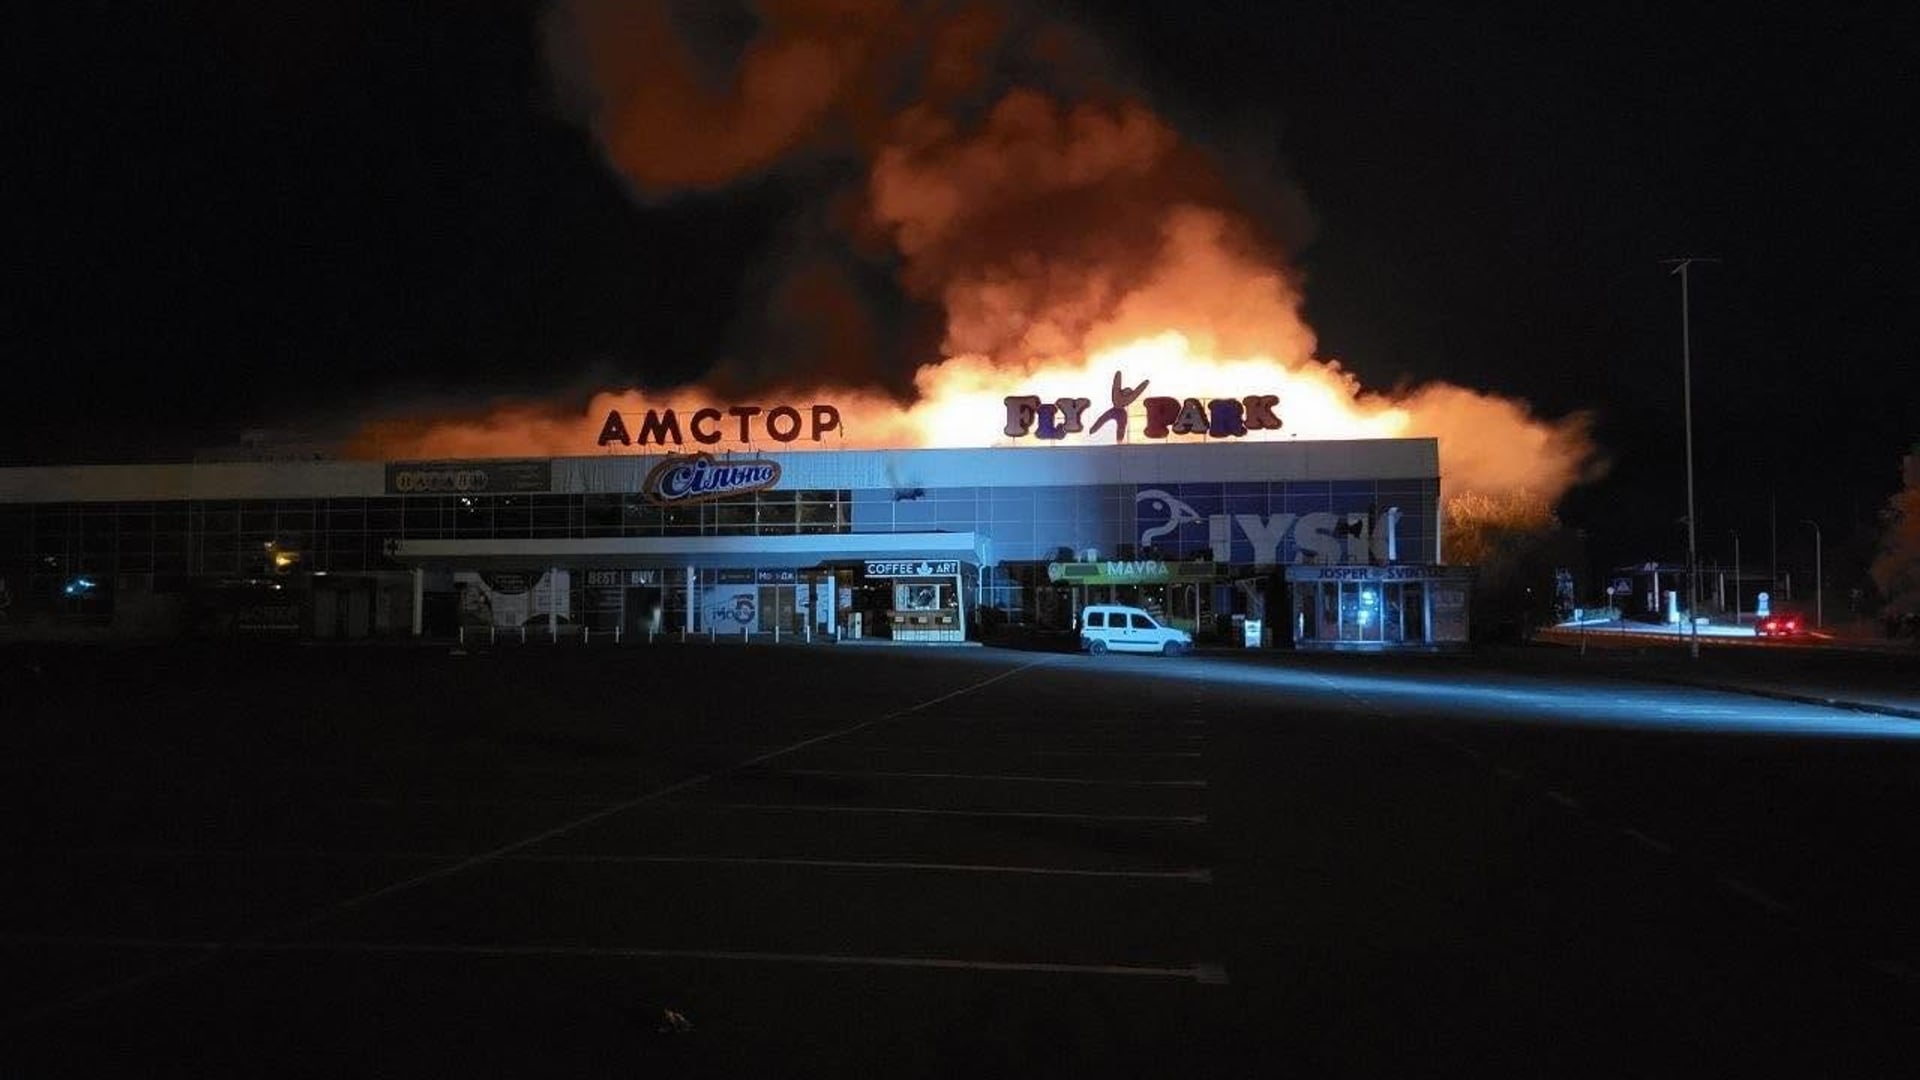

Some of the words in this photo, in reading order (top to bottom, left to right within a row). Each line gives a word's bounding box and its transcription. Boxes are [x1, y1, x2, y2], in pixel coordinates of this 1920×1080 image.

[598, 405, 839, 446] АМСТОР
[1004, 395, 1091, 440] FLY
[1144, 395, 1282, 438] PARK
[661, 461, 773, 498] Сільпо
[867, 563, 914, 574] COFFEE
[936, 563, 957, 573] ART
[1106, 561, 1169, 577] MAVRA
[1319, 567, 1369, 579] JOSPER
[588, 572, 617, 585] BEST
[632, 571, 655, 585] BUY
